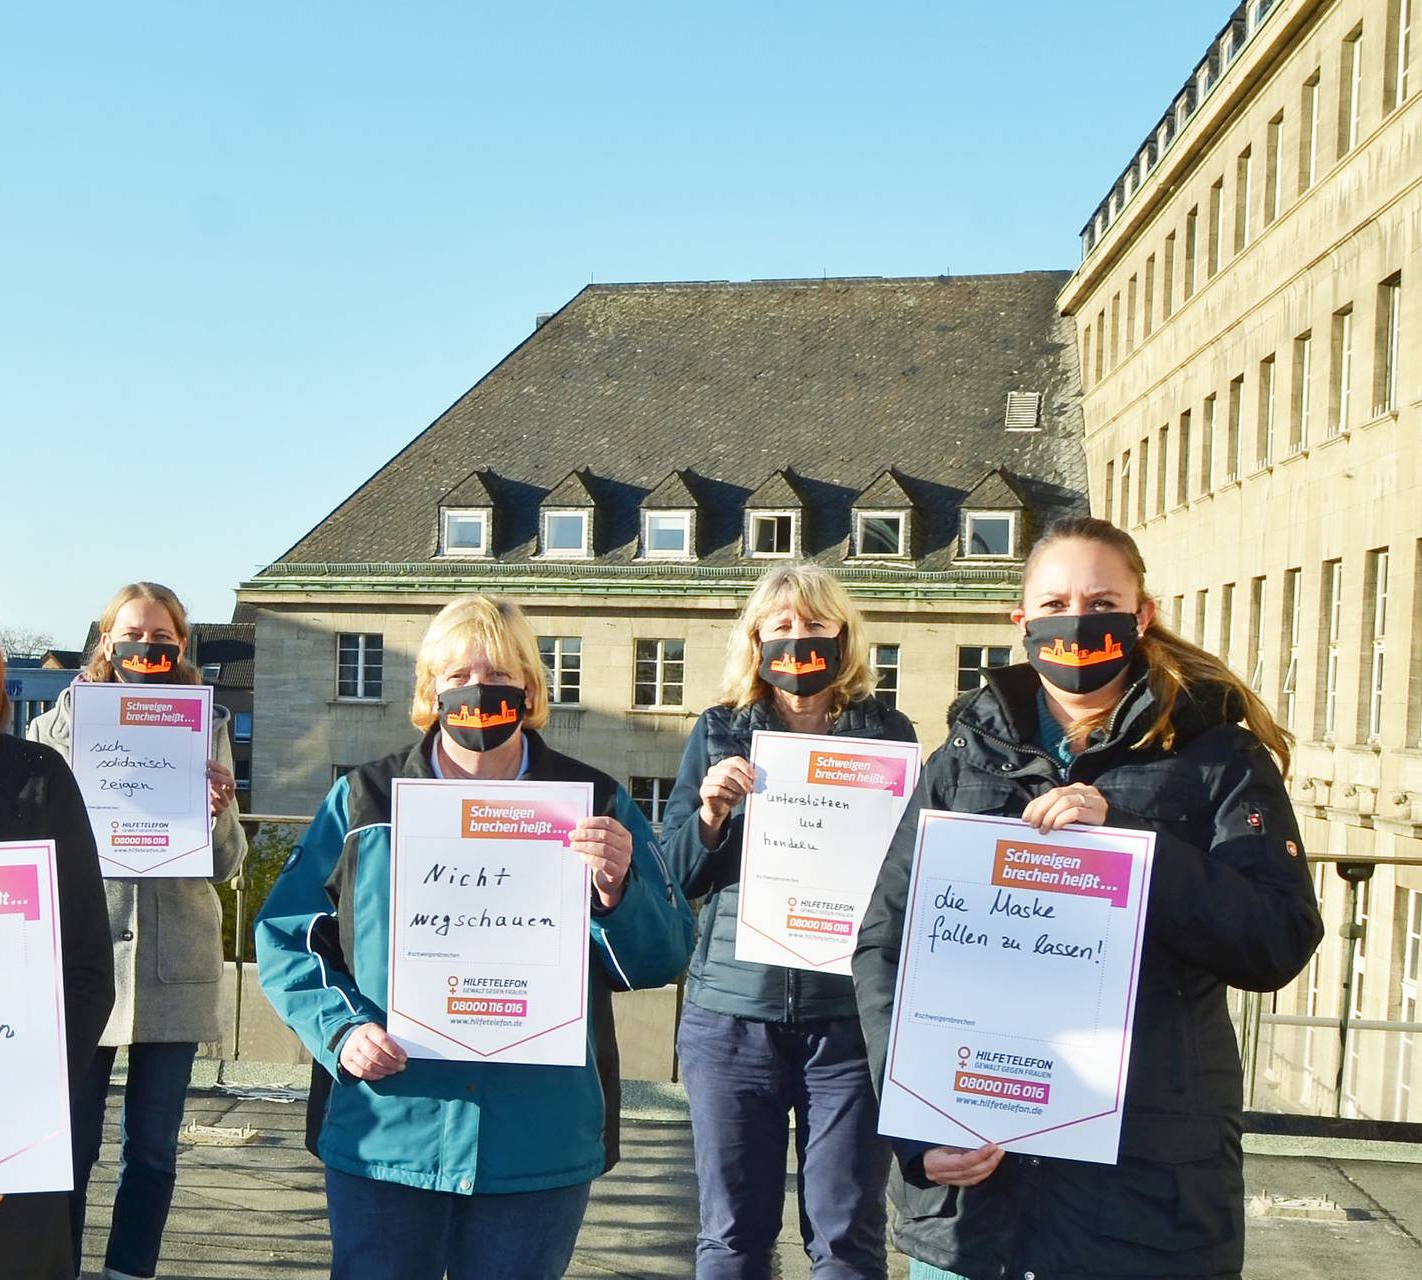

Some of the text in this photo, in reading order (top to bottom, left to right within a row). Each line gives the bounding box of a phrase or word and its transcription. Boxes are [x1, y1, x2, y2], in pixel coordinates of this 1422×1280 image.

[126, 701, 173, 712] Schweigen
[126, 711, 161, 721] brechen
[90, 740, 130, 753] sich
[96, 756, 177, 770] solidarisch
[816, 756, 871, 770] Schweigen
[815, 768, 856, 781] brechen
[470, 805, 535, 819] Schweigen
[469, 819, 518, 833] brechen
[1004, 848, 1081, 868] Schweigen
[423, 863, 511, 887] Nicht
[1002, 865, 1059, 884] brechen
[800, 900, 855, 912] HILFETELEFON
[934, 885, 1057, 918] die Maske
[409, 908, 557, 936] wegschauen
[928, 915, 1103, 964] fallen zu lassen!
[463, 978, 528, 988] HILFETELEFON
[451, 1001, 523, 1013] 08000 116 016
[975, 1050, 1054, 1070] HILFETELEFON
[959, 1076, 1045, 1099] 08000 116 016
[956, 1096, 1043, 1115] www.hilfetelefon.de
